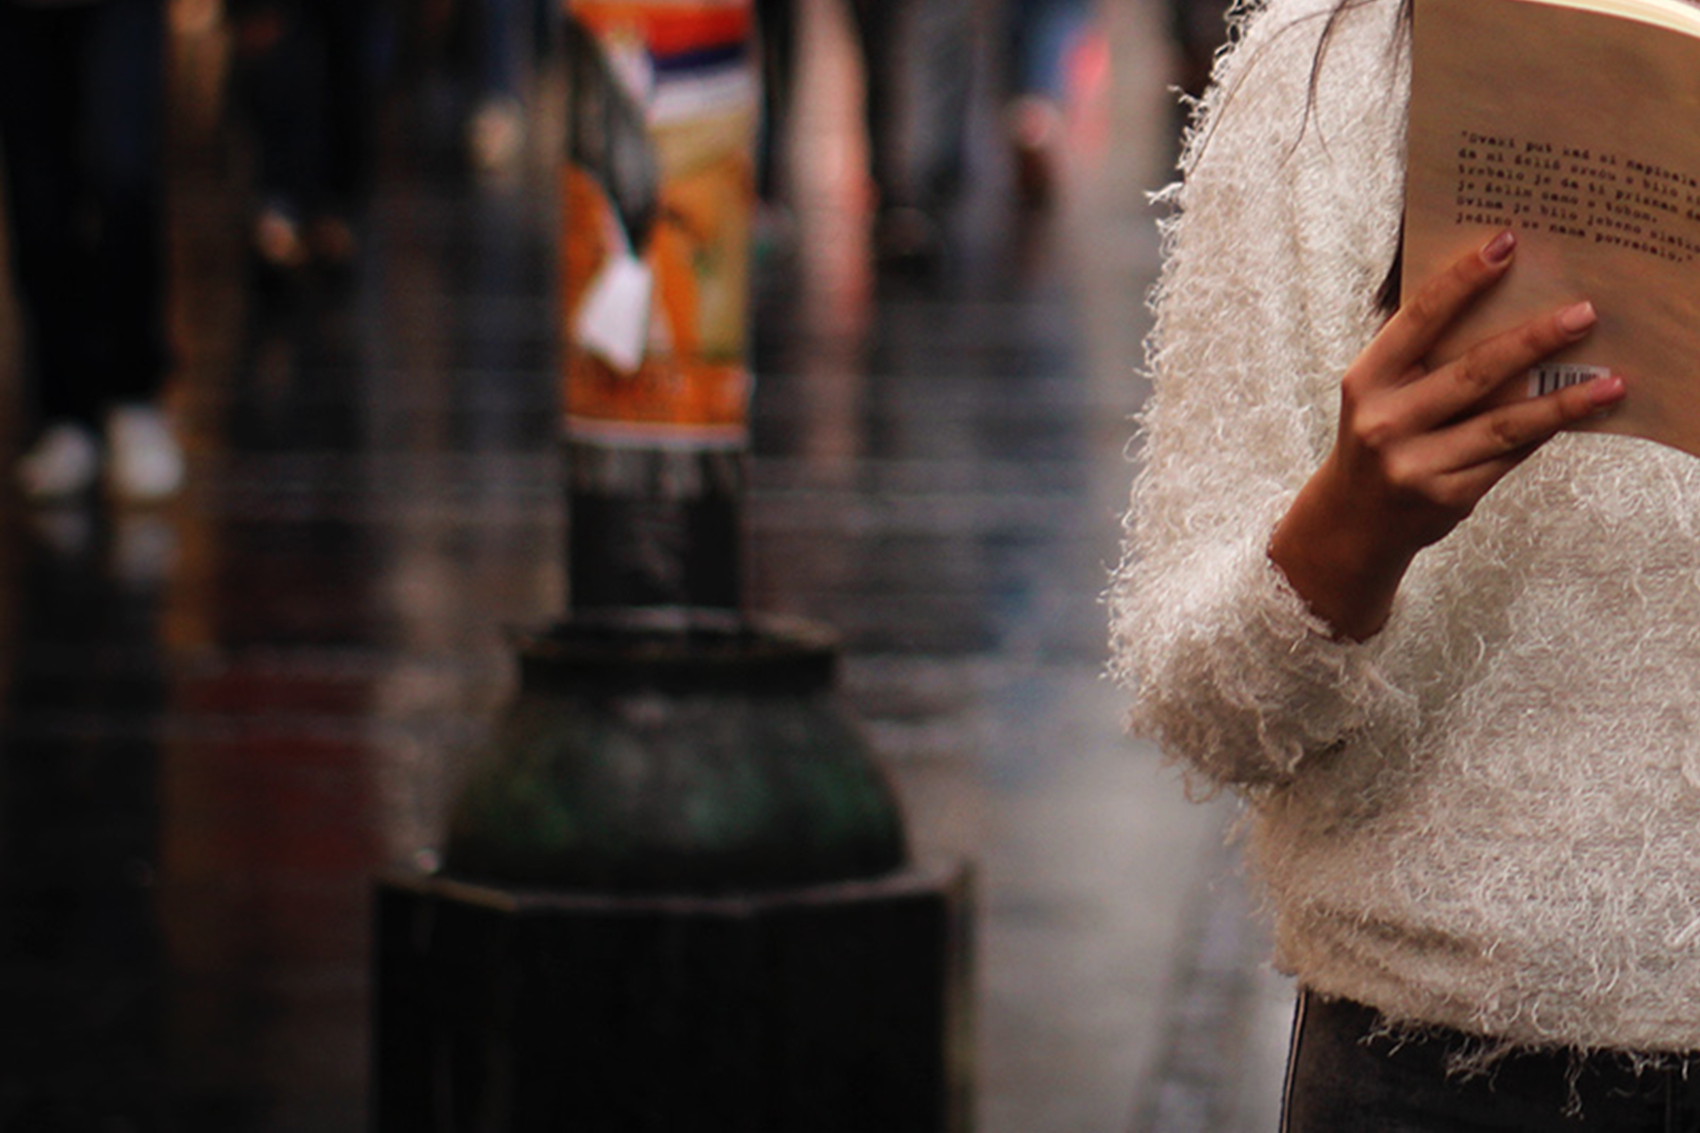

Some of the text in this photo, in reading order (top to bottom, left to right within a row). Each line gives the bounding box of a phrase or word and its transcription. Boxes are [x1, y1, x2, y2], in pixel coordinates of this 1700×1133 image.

[1457, 147, 1477, 160] da
[1456, 179, 1474, 193] je
[1532, 173, 1551, 187] je
[1559, 177, 1579, 190] da
[1512, 202, 1530, 215] je
